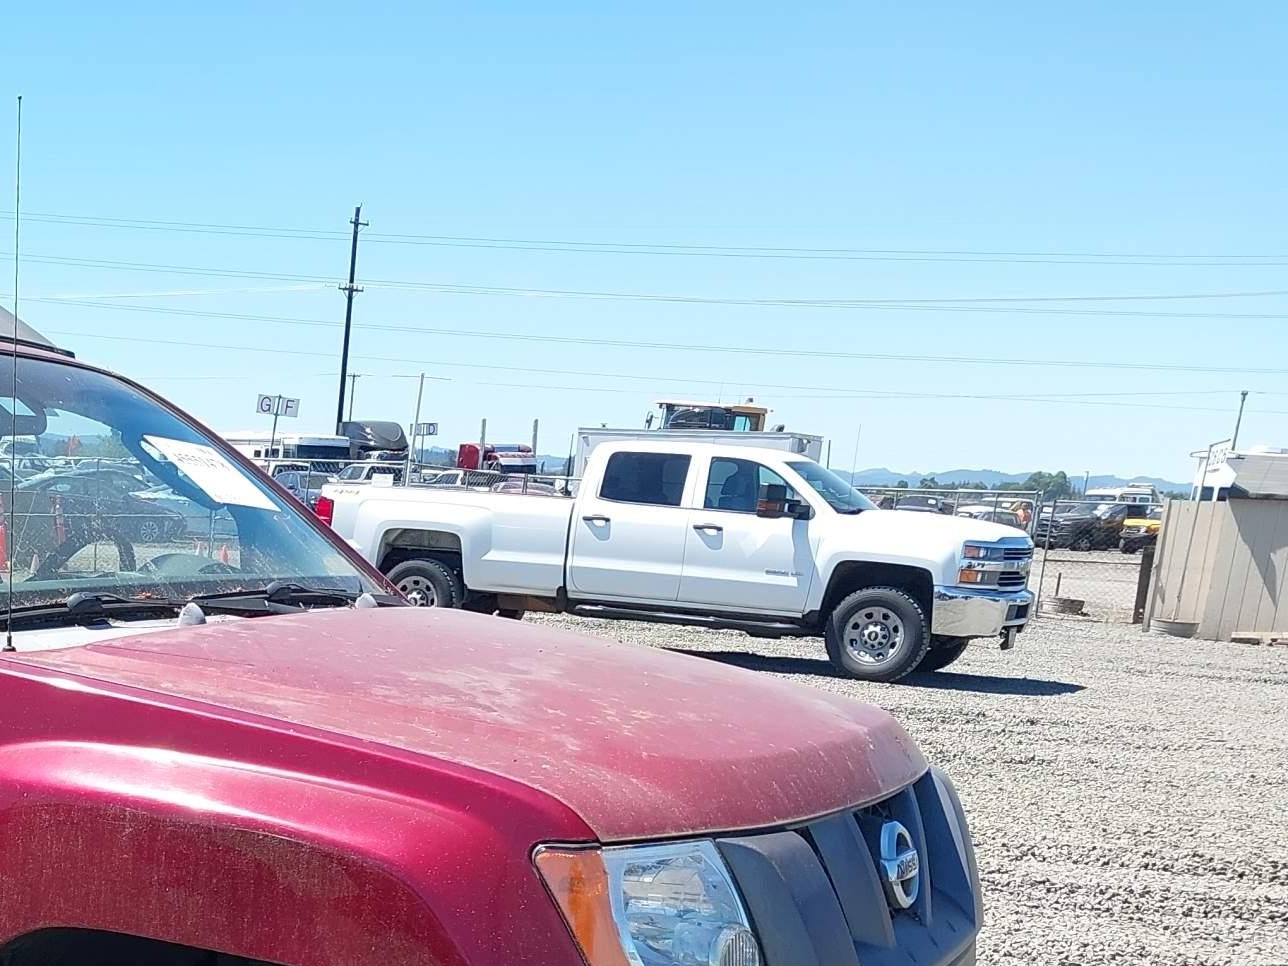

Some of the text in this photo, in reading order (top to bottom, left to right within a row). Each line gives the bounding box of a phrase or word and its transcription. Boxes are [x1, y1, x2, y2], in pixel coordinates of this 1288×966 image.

[260, 396, 272, 413] G
[284, 399, 296, 415] F
[429, 424, 436, 434] D
